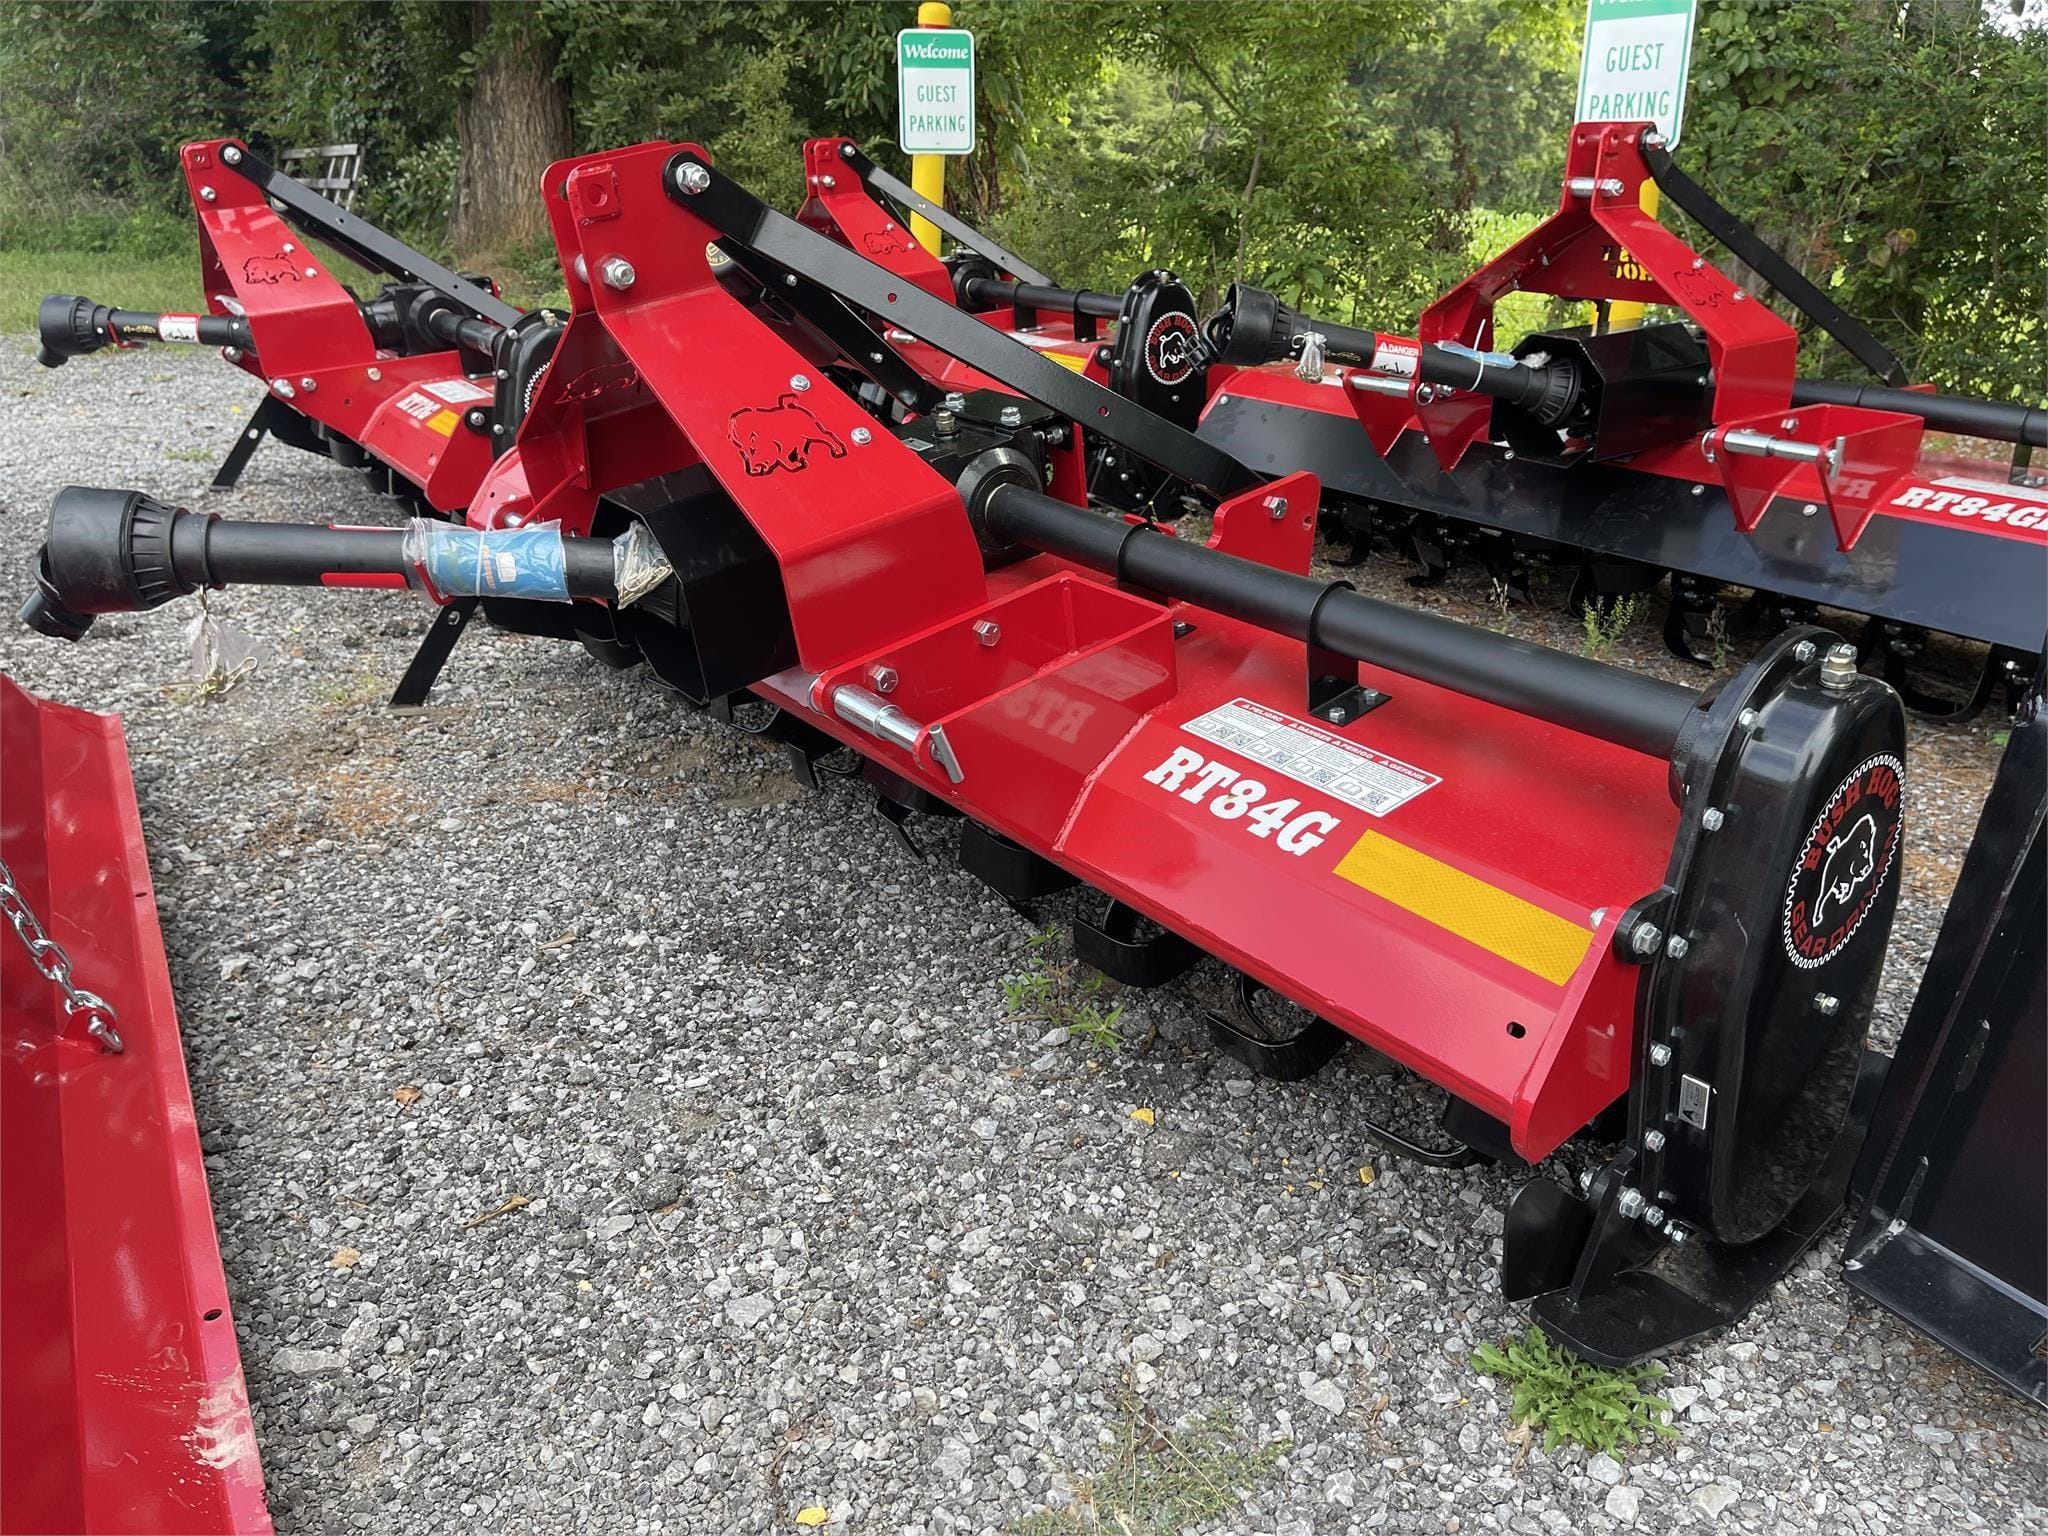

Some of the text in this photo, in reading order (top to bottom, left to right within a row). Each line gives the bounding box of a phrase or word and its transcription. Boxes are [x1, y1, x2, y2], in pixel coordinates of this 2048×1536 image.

[903, 43, 969, 60] Welcome
[1605, 43, 1665, 73] GUEST
[916, 85, 957, 103] GUEST
[1588, 90, 1671, 120] PARKING
[909, 115, 966, 132] PARKING
[1149, 316, 1172, 346] BUSH
[1389, 343, 1419, 358] DANGER
[1249, 706, 1284, 722] PELIGRO
[1297, 725, 1333, 742] DANGER
[1340, 743, 1375, 759] PERIGO
[1389, 763, 1426, 781] GEFAHR
[1141, 744, 1343, 858] RT84G
[1802, 766, 1900, 871] BUSH HOG
[1792, 900, 1827, 957] GEAR
